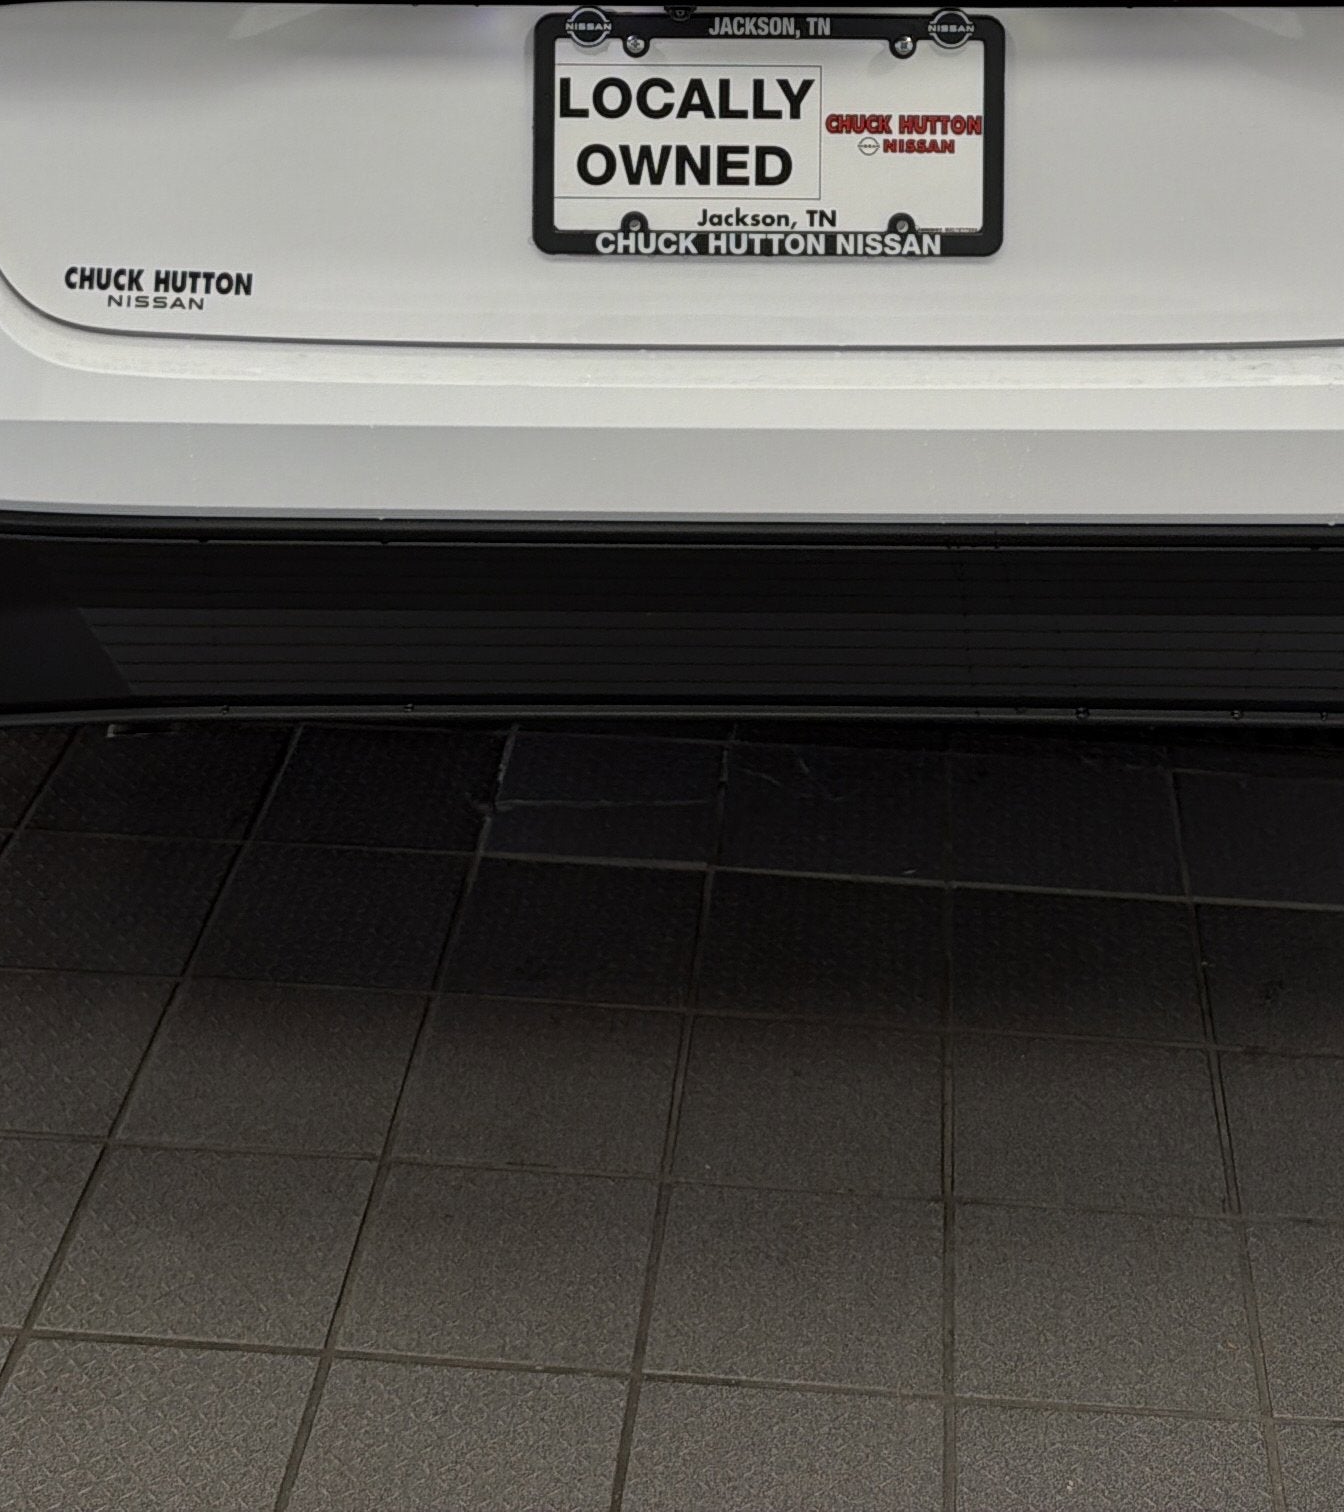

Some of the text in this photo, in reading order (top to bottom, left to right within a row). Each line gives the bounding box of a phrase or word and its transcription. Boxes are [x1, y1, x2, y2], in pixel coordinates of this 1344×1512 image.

[565, 22, 612, 31] NISSAN
[709, 17, 831, 39] JACKSON, TN
[928, 24, 975, 33] NISSAN
[559, 77, 816, 120] LOCALLY
[825, 114, 982, 135] CHUCK HUTTON
[882, 138, 956, 154] NISSAN
[576, 144, 793, 187] OWNED
[697, 208, 837, 230] Jackson, TN
[595, 232, 942, 256] CHUCK HUTTON NISSAN
[64, 266, 253, 296] CHUCK HUTTON
[107, 294, 205, 311] NISSAN
